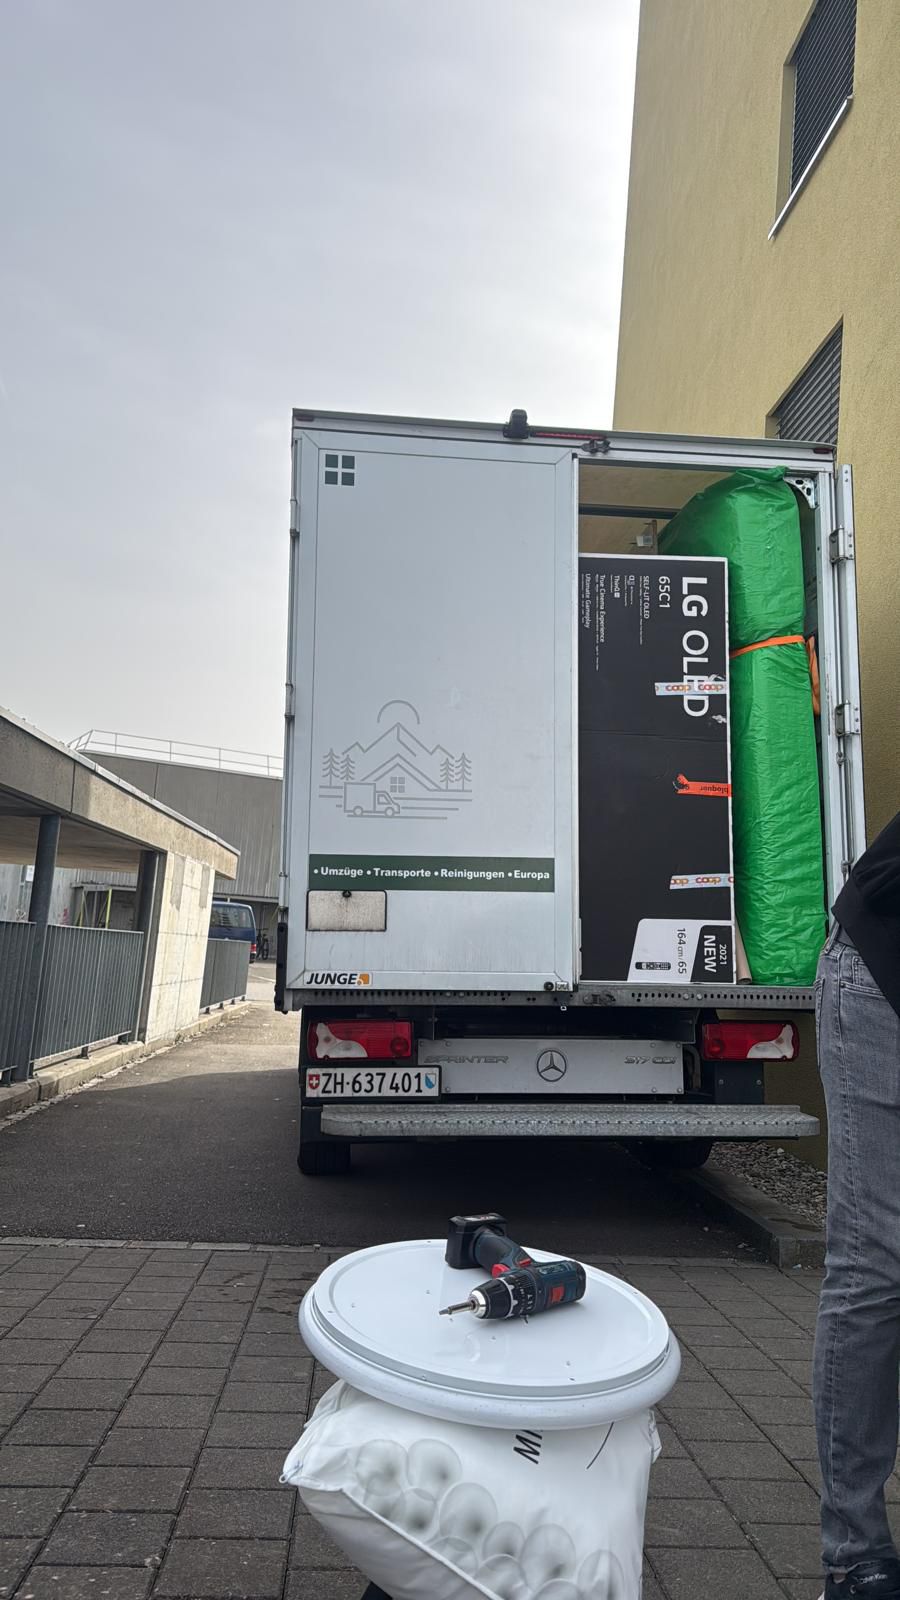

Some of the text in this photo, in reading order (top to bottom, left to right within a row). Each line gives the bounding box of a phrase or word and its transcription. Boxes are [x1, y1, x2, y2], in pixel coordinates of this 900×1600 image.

[613, 575, 621, 592] ThinQ
[658, 575, 671, 608] 65C1
[682, 576, 709, 617] LG
[598, 610, 606, 643] Experience
[666, 684, 691, 692] coop
[698, 684, 724, 692] coop
[320, 866, 550, 880] Umzüge Transporte Reinigungen Europa
[696, 876, 721, 885] coop
[677, 928, 687, 945] 164
[677, 946, 684, 957] cm
[703, 934, 717, 973] NEW
[719, 944, 727, 965] 2021
[677, 961, 687, 974] 65
[306, 973, 358, 985] JUNGE
[424, 1055, 510, 1064] SPRINTER
